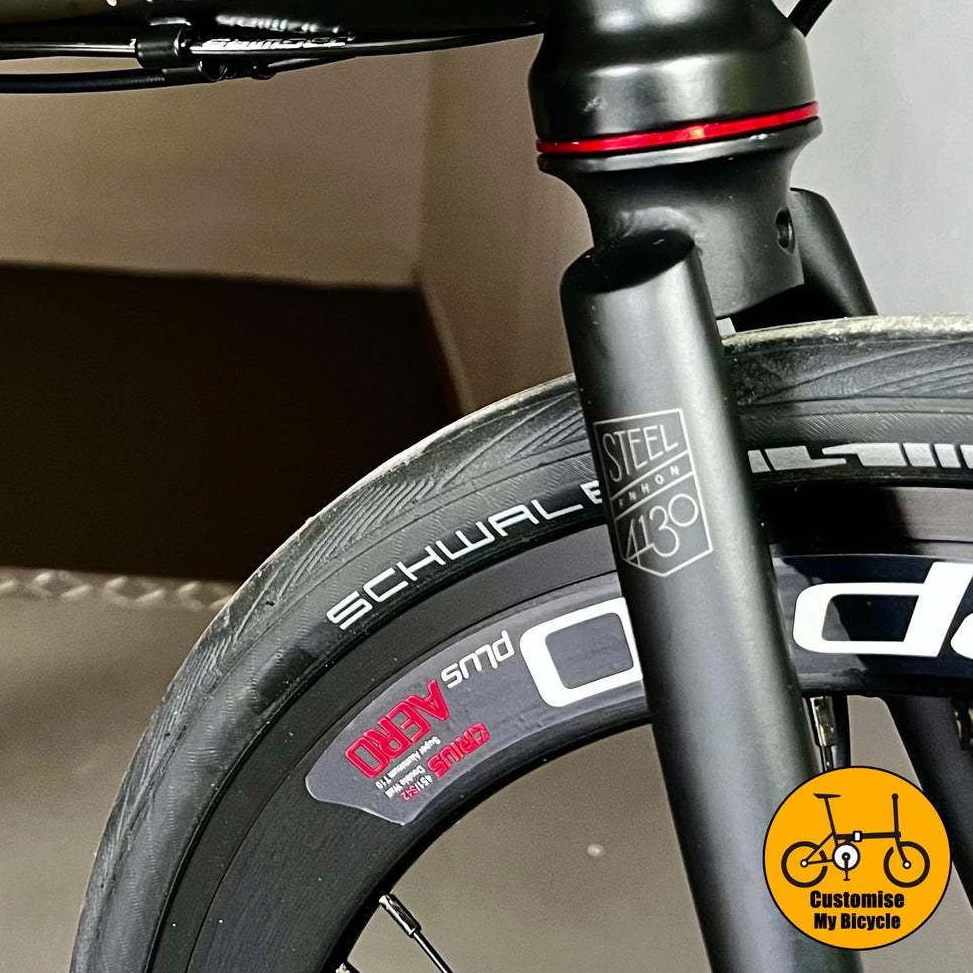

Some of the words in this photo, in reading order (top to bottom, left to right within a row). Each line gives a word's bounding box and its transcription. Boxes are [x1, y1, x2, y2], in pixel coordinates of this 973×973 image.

[603, 425, 679, 483] STEEL
[618, 465, 680, 510] FNHON
[627, 493, 699, 567] 4130
[345, 679, 449, 778] AERO
[418, 736, 442, 756] Super
[427, 723, 490, 778] CRIUS
[399, 765, 426, 785] Double
